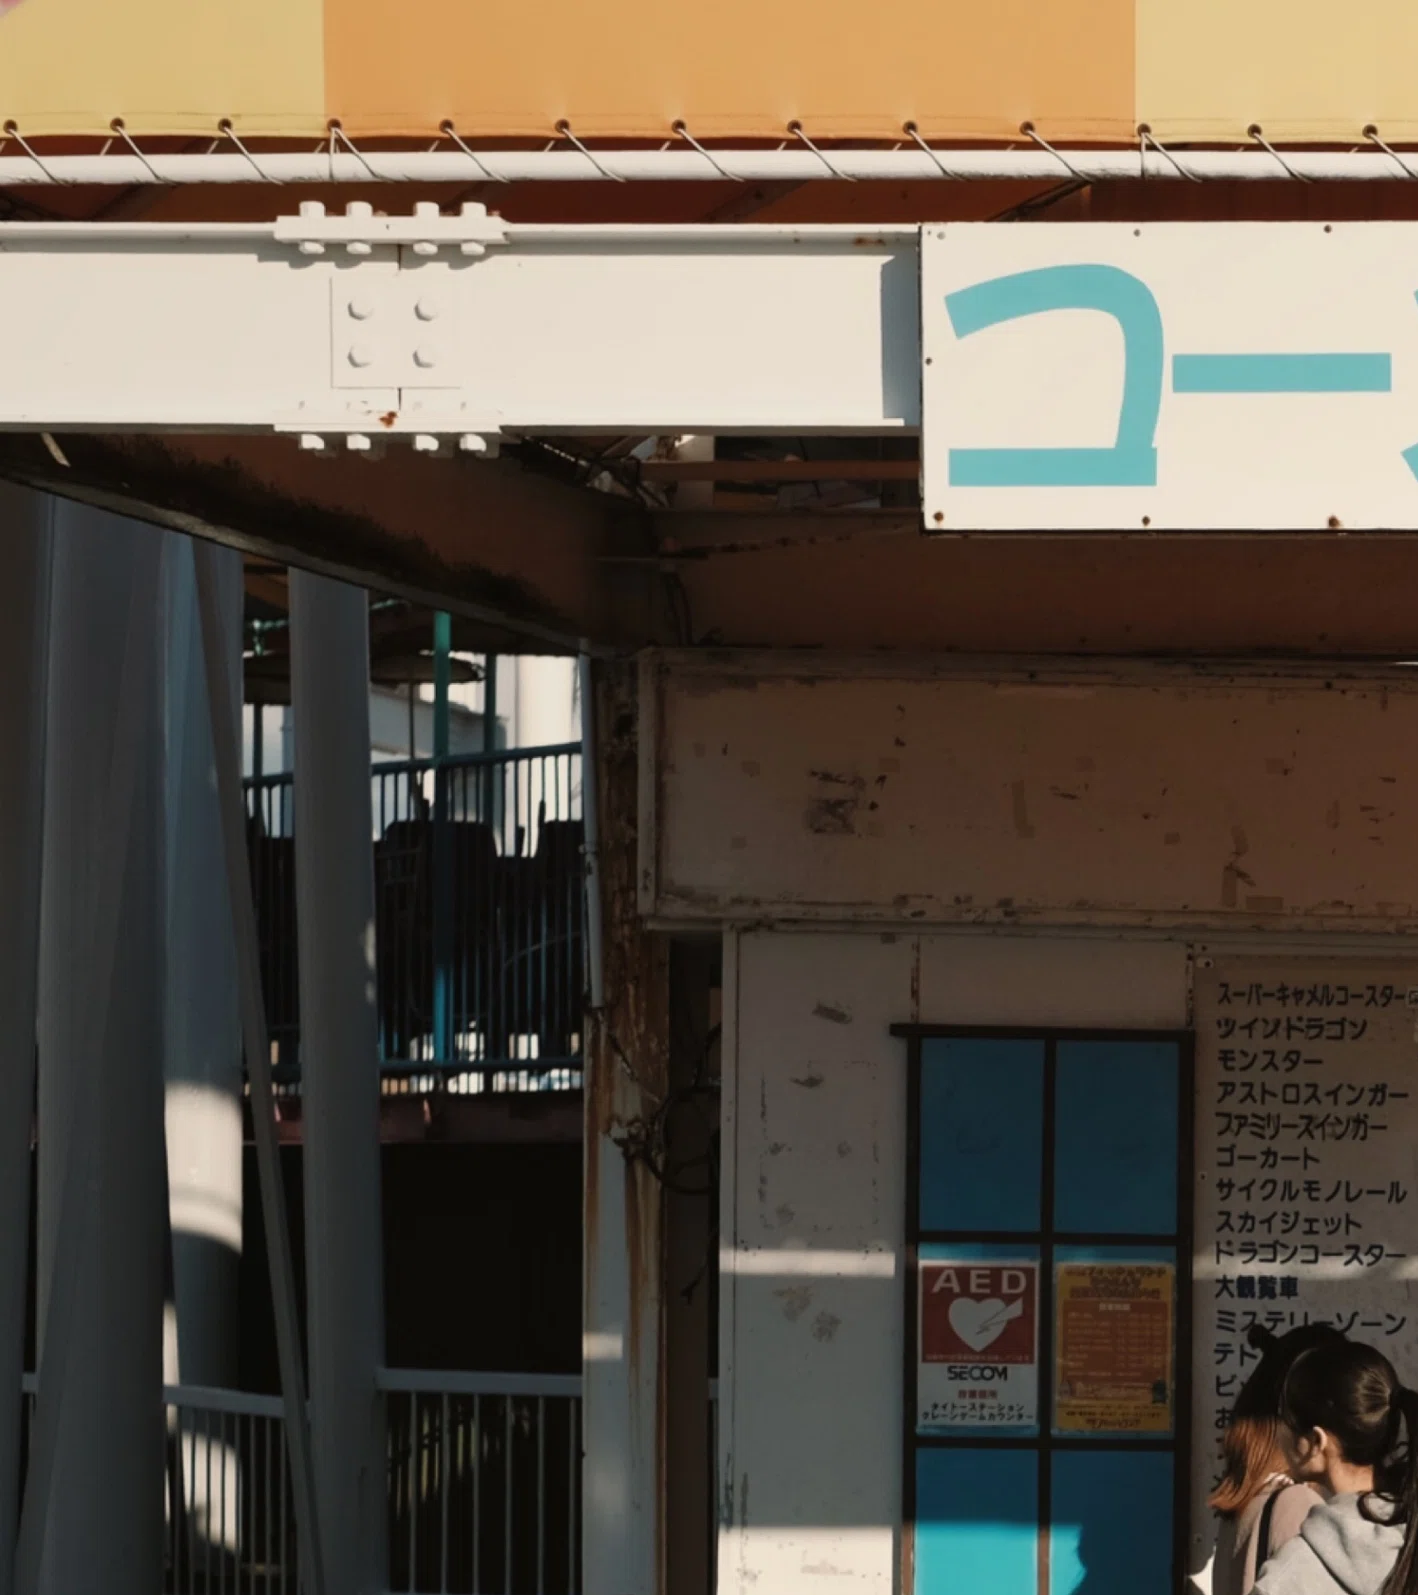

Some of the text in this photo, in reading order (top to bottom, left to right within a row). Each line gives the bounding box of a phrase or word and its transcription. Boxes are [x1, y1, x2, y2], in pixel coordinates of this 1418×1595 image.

[1217, 983, 1406, 1007] スーパーキャメルコースター
[1216, 1016, 1368, 1040] ツインドラゴン
[1217, 1050, 1324, 1073] モンスター
[1216, 1082, 1409, 1107] アストロスインガー
[1215, 1112, 1388, 1140] ファミリースインガー
[1216, 1146, 1321, 1169] ゴーカート
[1215, 1177, 1408, 1204] サイクルモノレール
[1215, 1210, 1362, 1235] スカイジェット
[1215, 1240, 1407, 1265] ドラゴンコースター
[931, 1268, 1027, 1295] AED
[1214, 1342, 1259, 1367] テト
[947, 1365, 1009, 1382] SECOM
